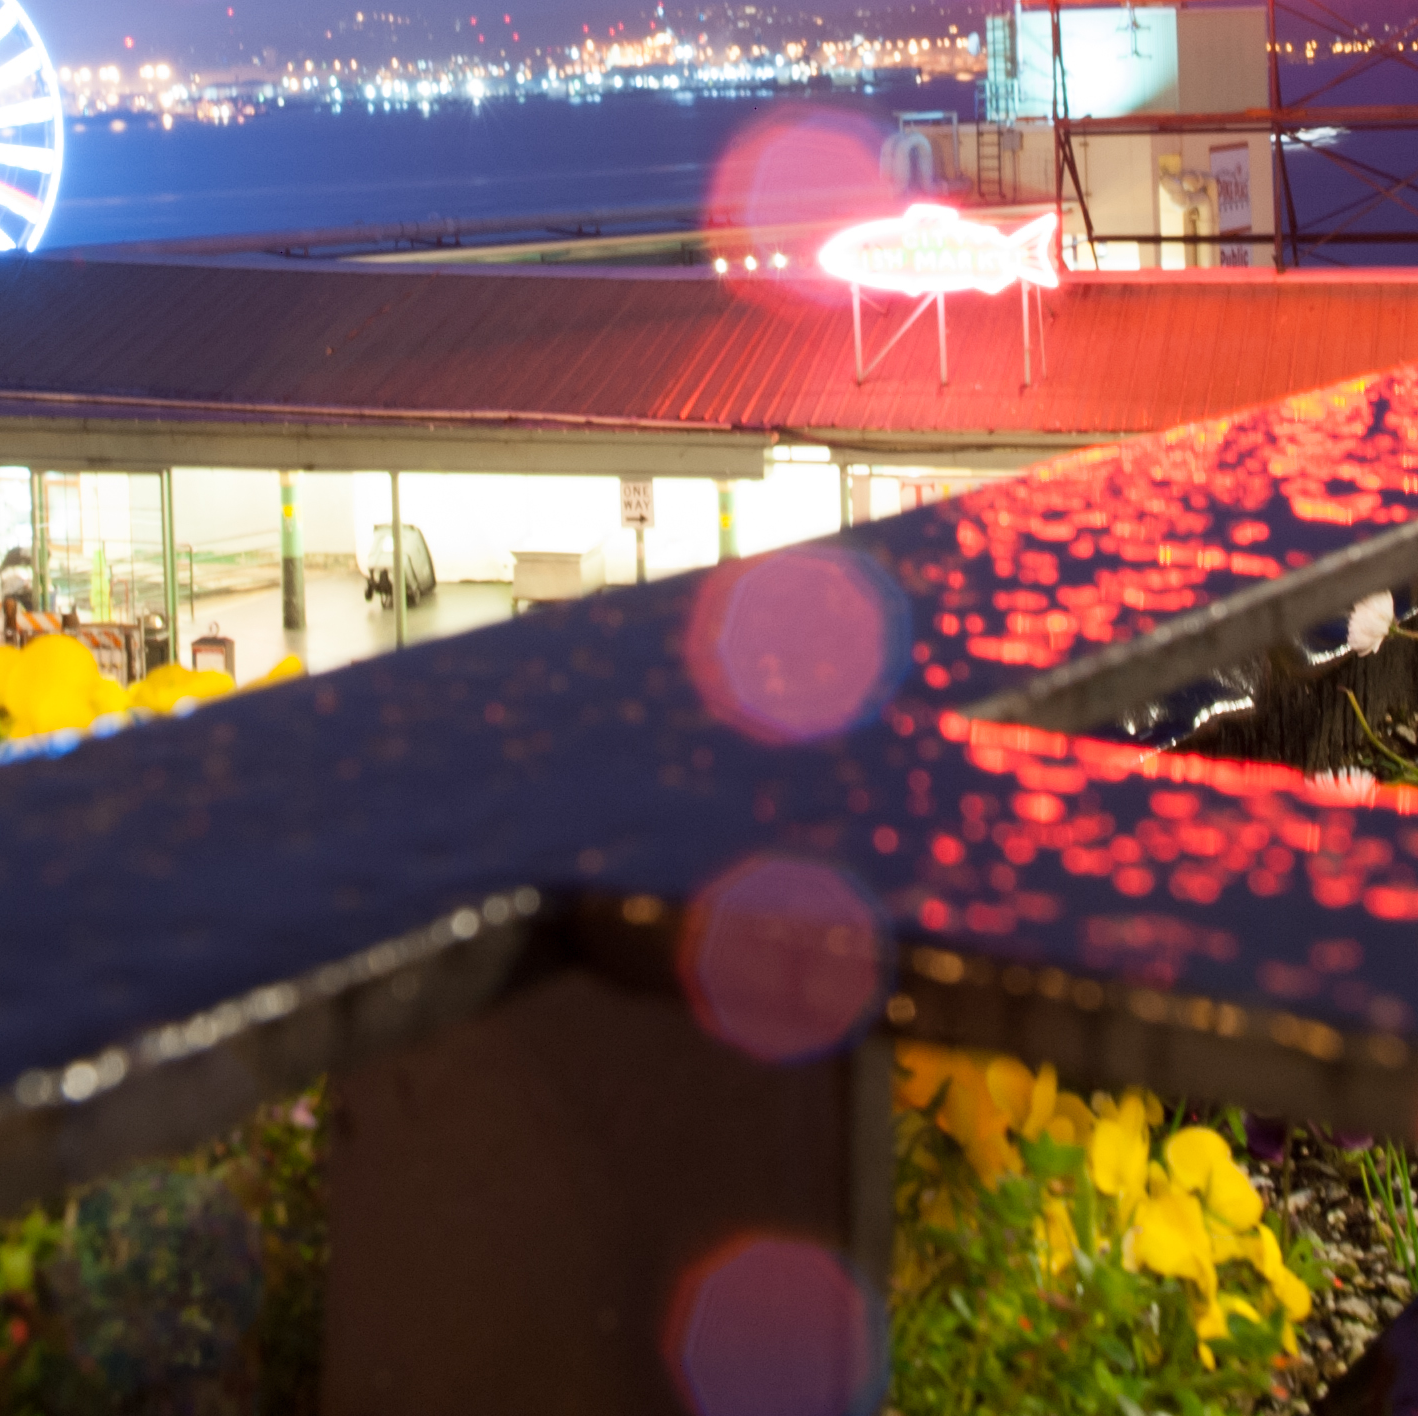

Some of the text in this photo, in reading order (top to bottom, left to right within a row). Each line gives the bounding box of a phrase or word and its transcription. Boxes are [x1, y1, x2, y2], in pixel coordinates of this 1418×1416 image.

[849, 247, 1026, 272] ISH MARKT
[624, 485, 649, 497] ONE
[624, 499, 650, 511] WAY
